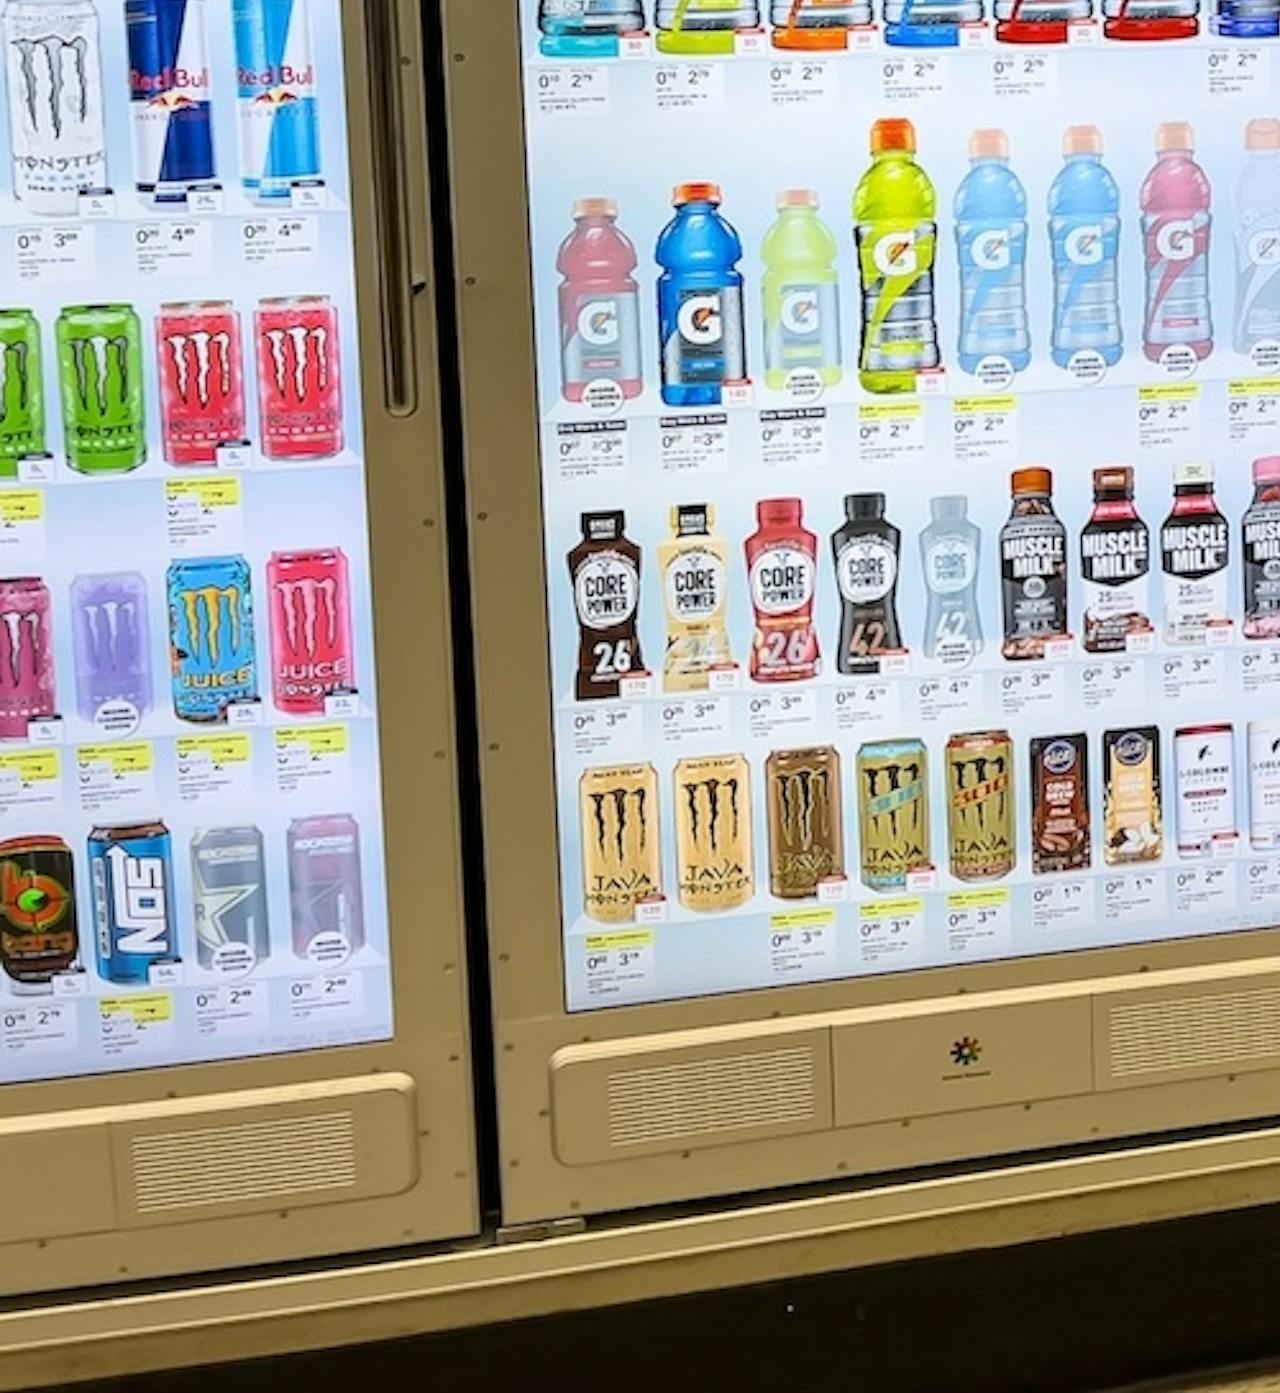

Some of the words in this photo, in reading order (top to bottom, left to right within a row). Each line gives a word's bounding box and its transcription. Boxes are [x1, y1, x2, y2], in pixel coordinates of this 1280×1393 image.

[1003, 537, 1063, 556] MUSCLE
[1082, 532, 1147, 553] MUSCLE
[1163, 524, 1227, 548] MUSCLE
[850, 558, 885, 577] CORE
[1013, 554, 1055, 576] MILK
[1092, 553, 1138, 577] MILK
[1173, 547, 1217, 571] MILK
[585, 574, 626, 596] CORE
[676, 569, 715, 592] CORE
[760, 566, 804, 588] CORE
[852, 575, 885, 588] POWER
[587, 597, 627, 614] POWER
[677, 593, 715, 609] POWER
[763, 589, 804, 603] POWER
[852, 622, 885, 651] 42
[594, 642, 631, 674] 26
[766, 630, 802, 665] 26
[181, 670, 253, 688] JUICE
[279, 660, 347, 678] JUICE
[867, 843, 923, 863] JAVA
[955, 833, 1008, 852] JAVA
[593, 870, 652, 892] JAVA
[685, 860, 744, 881] JAVA
[108, 844, 168, 954] NOS
